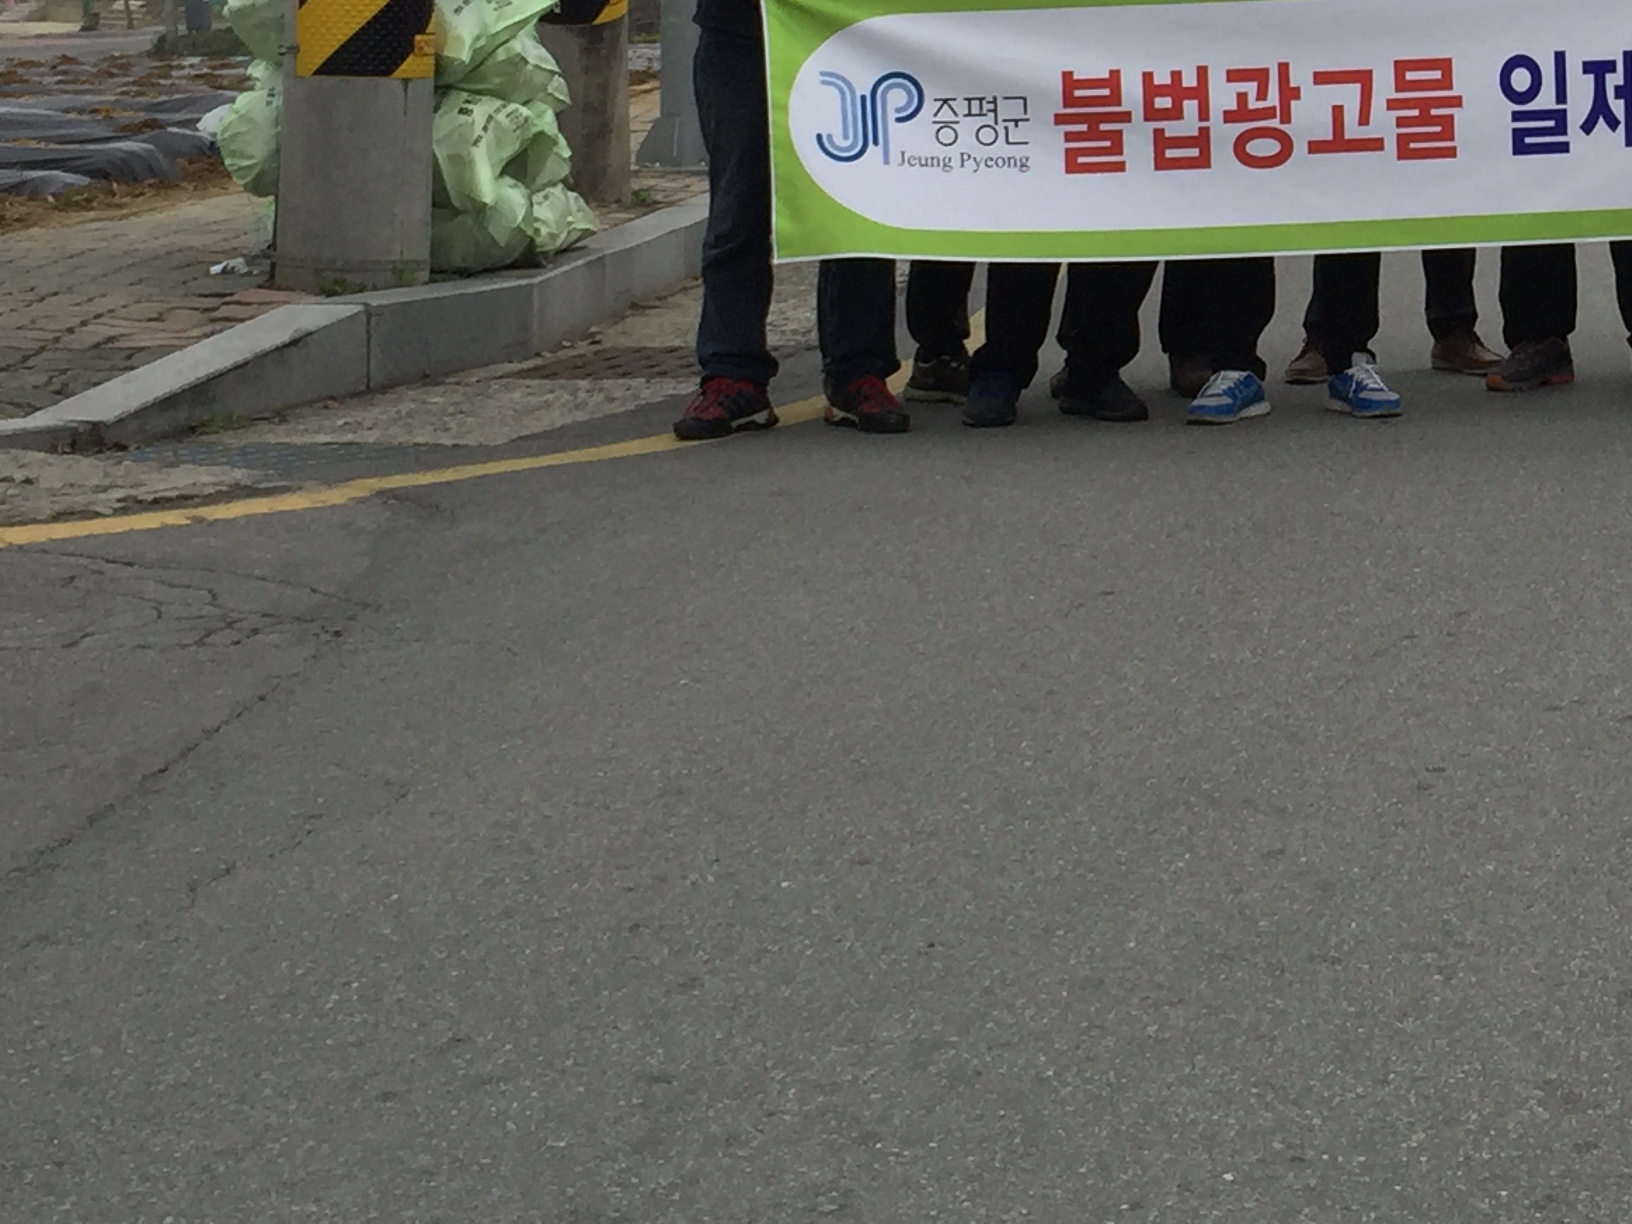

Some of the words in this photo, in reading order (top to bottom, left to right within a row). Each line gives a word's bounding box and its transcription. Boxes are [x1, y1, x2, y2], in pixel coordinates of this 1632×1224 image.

[931, 95, 1030, 147] 증평군
[1053, 57, 1463, 175] 불법광고물
[897, 150, 953, 173] Jeung
[959, 151, 1031, 173] Pyeong
